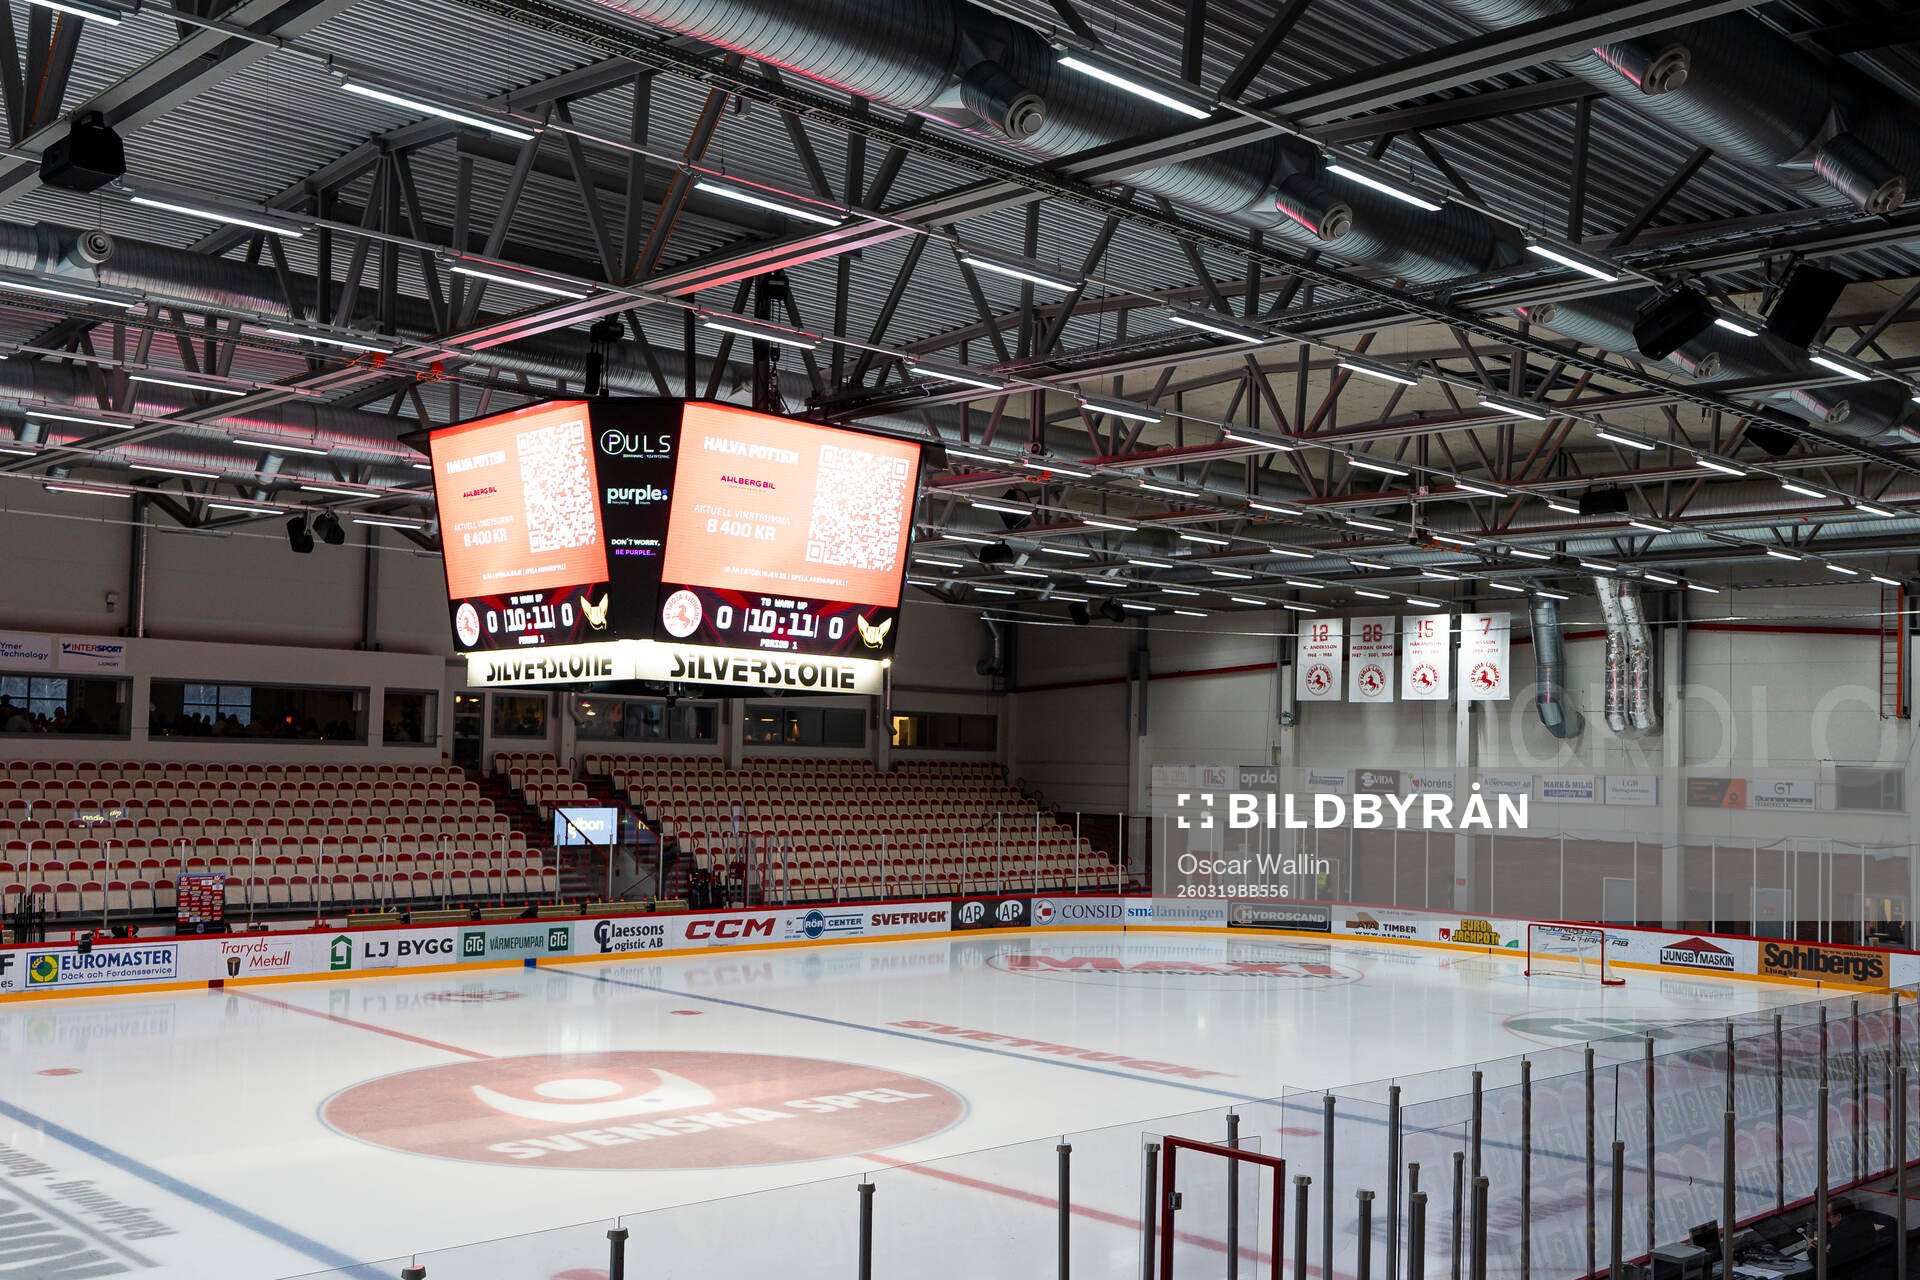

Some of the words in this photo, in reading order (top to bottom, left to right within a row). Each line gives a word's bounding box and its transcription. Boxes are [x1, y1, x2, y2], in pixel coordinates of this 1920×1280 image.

[603, 431, 671, 453] PULS
[704, 436, 747, 457] HALVA
[750, 445, 799, 465] POTTEN
[720, 475, 762, 488] AHLBERG
[762, 480, 776, 490] BIL
[694, 503, 732, 517] AKTUELL
[472, 530, 492, 546] 400
[493, 527, 508, 542] KR
[720, 520, 751, 538] 400
[754, 525, 776, 541] KR
[486, 610, 498, 634] 0
[506, 604, 554, 632] 10:11
[561, 603, 574, 627] 0
[716, 605, 733, 630] 0
[748, 608, 815, 638] 10:11
[828, 616, 844, 640] 0
[1480, 617, 1492, 635] 7
[1417, 620, 1434, 638] 15
[0, 650, 48, 660] Technology
[72, 644, 124, 653] INTERSPORT
[1374, 775, 1393, 784] VIDA
[1420, 778, 1453, 788] Noréns
[1543, 781, 1565, 789] MARK
[1565, 780, 1571, 788] &
[1572, 780, 1593, 789] MILJÖ
[1774, 782, 1794, 795] GT
[871, 910, 947, 926] SVETRUCK
[1062, 903, 1122, 919] CONSID
[1127, 903, 1224, 921] smålänningen
[1242, 909, 1326, 923] HYDROSCAND
[684, 918, 777, 940] CCM
[805, 918, 823, 928] RÖR
[828, 918, 862, 927] CENTER
[1358, 921, 1377, 930] ATA
[1383, 923, 1417, 933] TIMBER
[1461, 919, 1487, 932] EURO
[594, 920, 664, 944] Claessons
[1452, 929, 1498, 945] JACKPOT
[221, 937, 268, 957] Traryds
[365, 940, 389, 958] LJ
[397, 937, 454, 957] BYGG
[489, 935, 544, 951] VÄRMEPUMPAR
[600, 929, 645, 953] Logistic
[649, 937, 663, 948] AB
[62, 949, 172, 971] EUROMASTER
[249, 951, 291, 967] Metall
[1007, 955, 1343, 976] MAXI
[1700, 954, 1734, 967] MASKIN
[1764, 943, 1883, 981] Sohlbergs
[62, 972, 84, 981] Däck
[87, 971, 104, 979] och
[107, 967, 172, 978] Fordonsservice
[1765, 967, 1798, 977] Ljungby
[886, 1019, 1242, 1079] SVETRUCK
[487, 1106, 797, 1161] SVENSKA
[796, 1087, 934, 1115] SPEL
